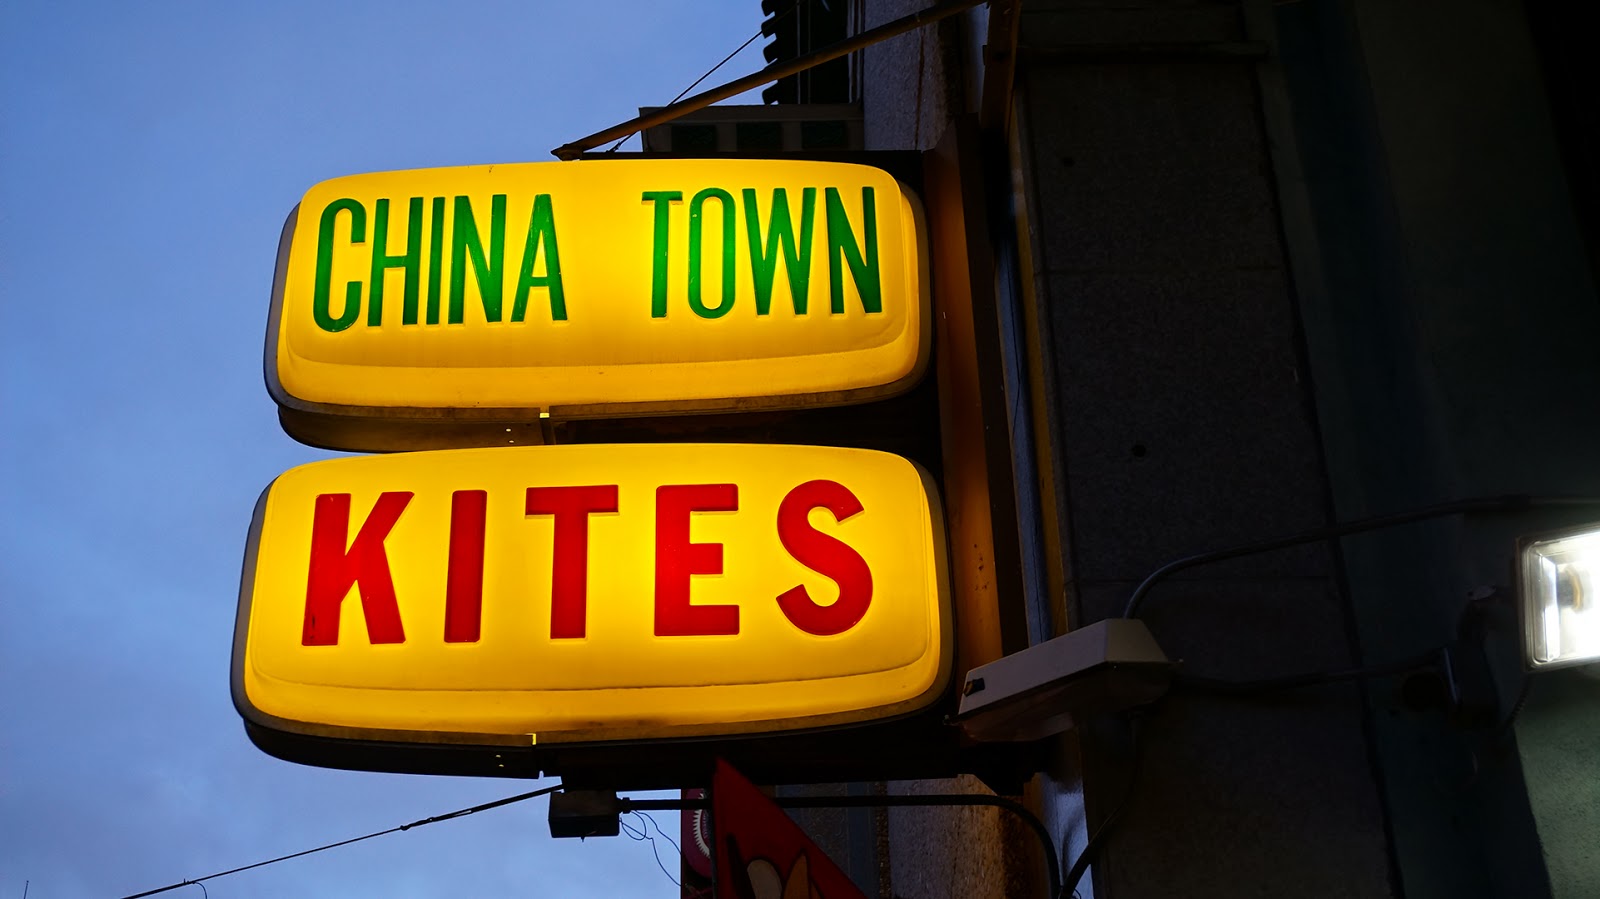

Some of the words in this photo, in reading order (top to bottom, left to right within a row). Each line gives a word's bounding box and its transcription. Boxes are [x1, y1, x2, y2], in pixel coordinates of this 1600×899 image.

[313, 193, 568, 333] CHINA
[642, 186, 882, 319] TOWN
[301, 479, 874, 647] KITES
